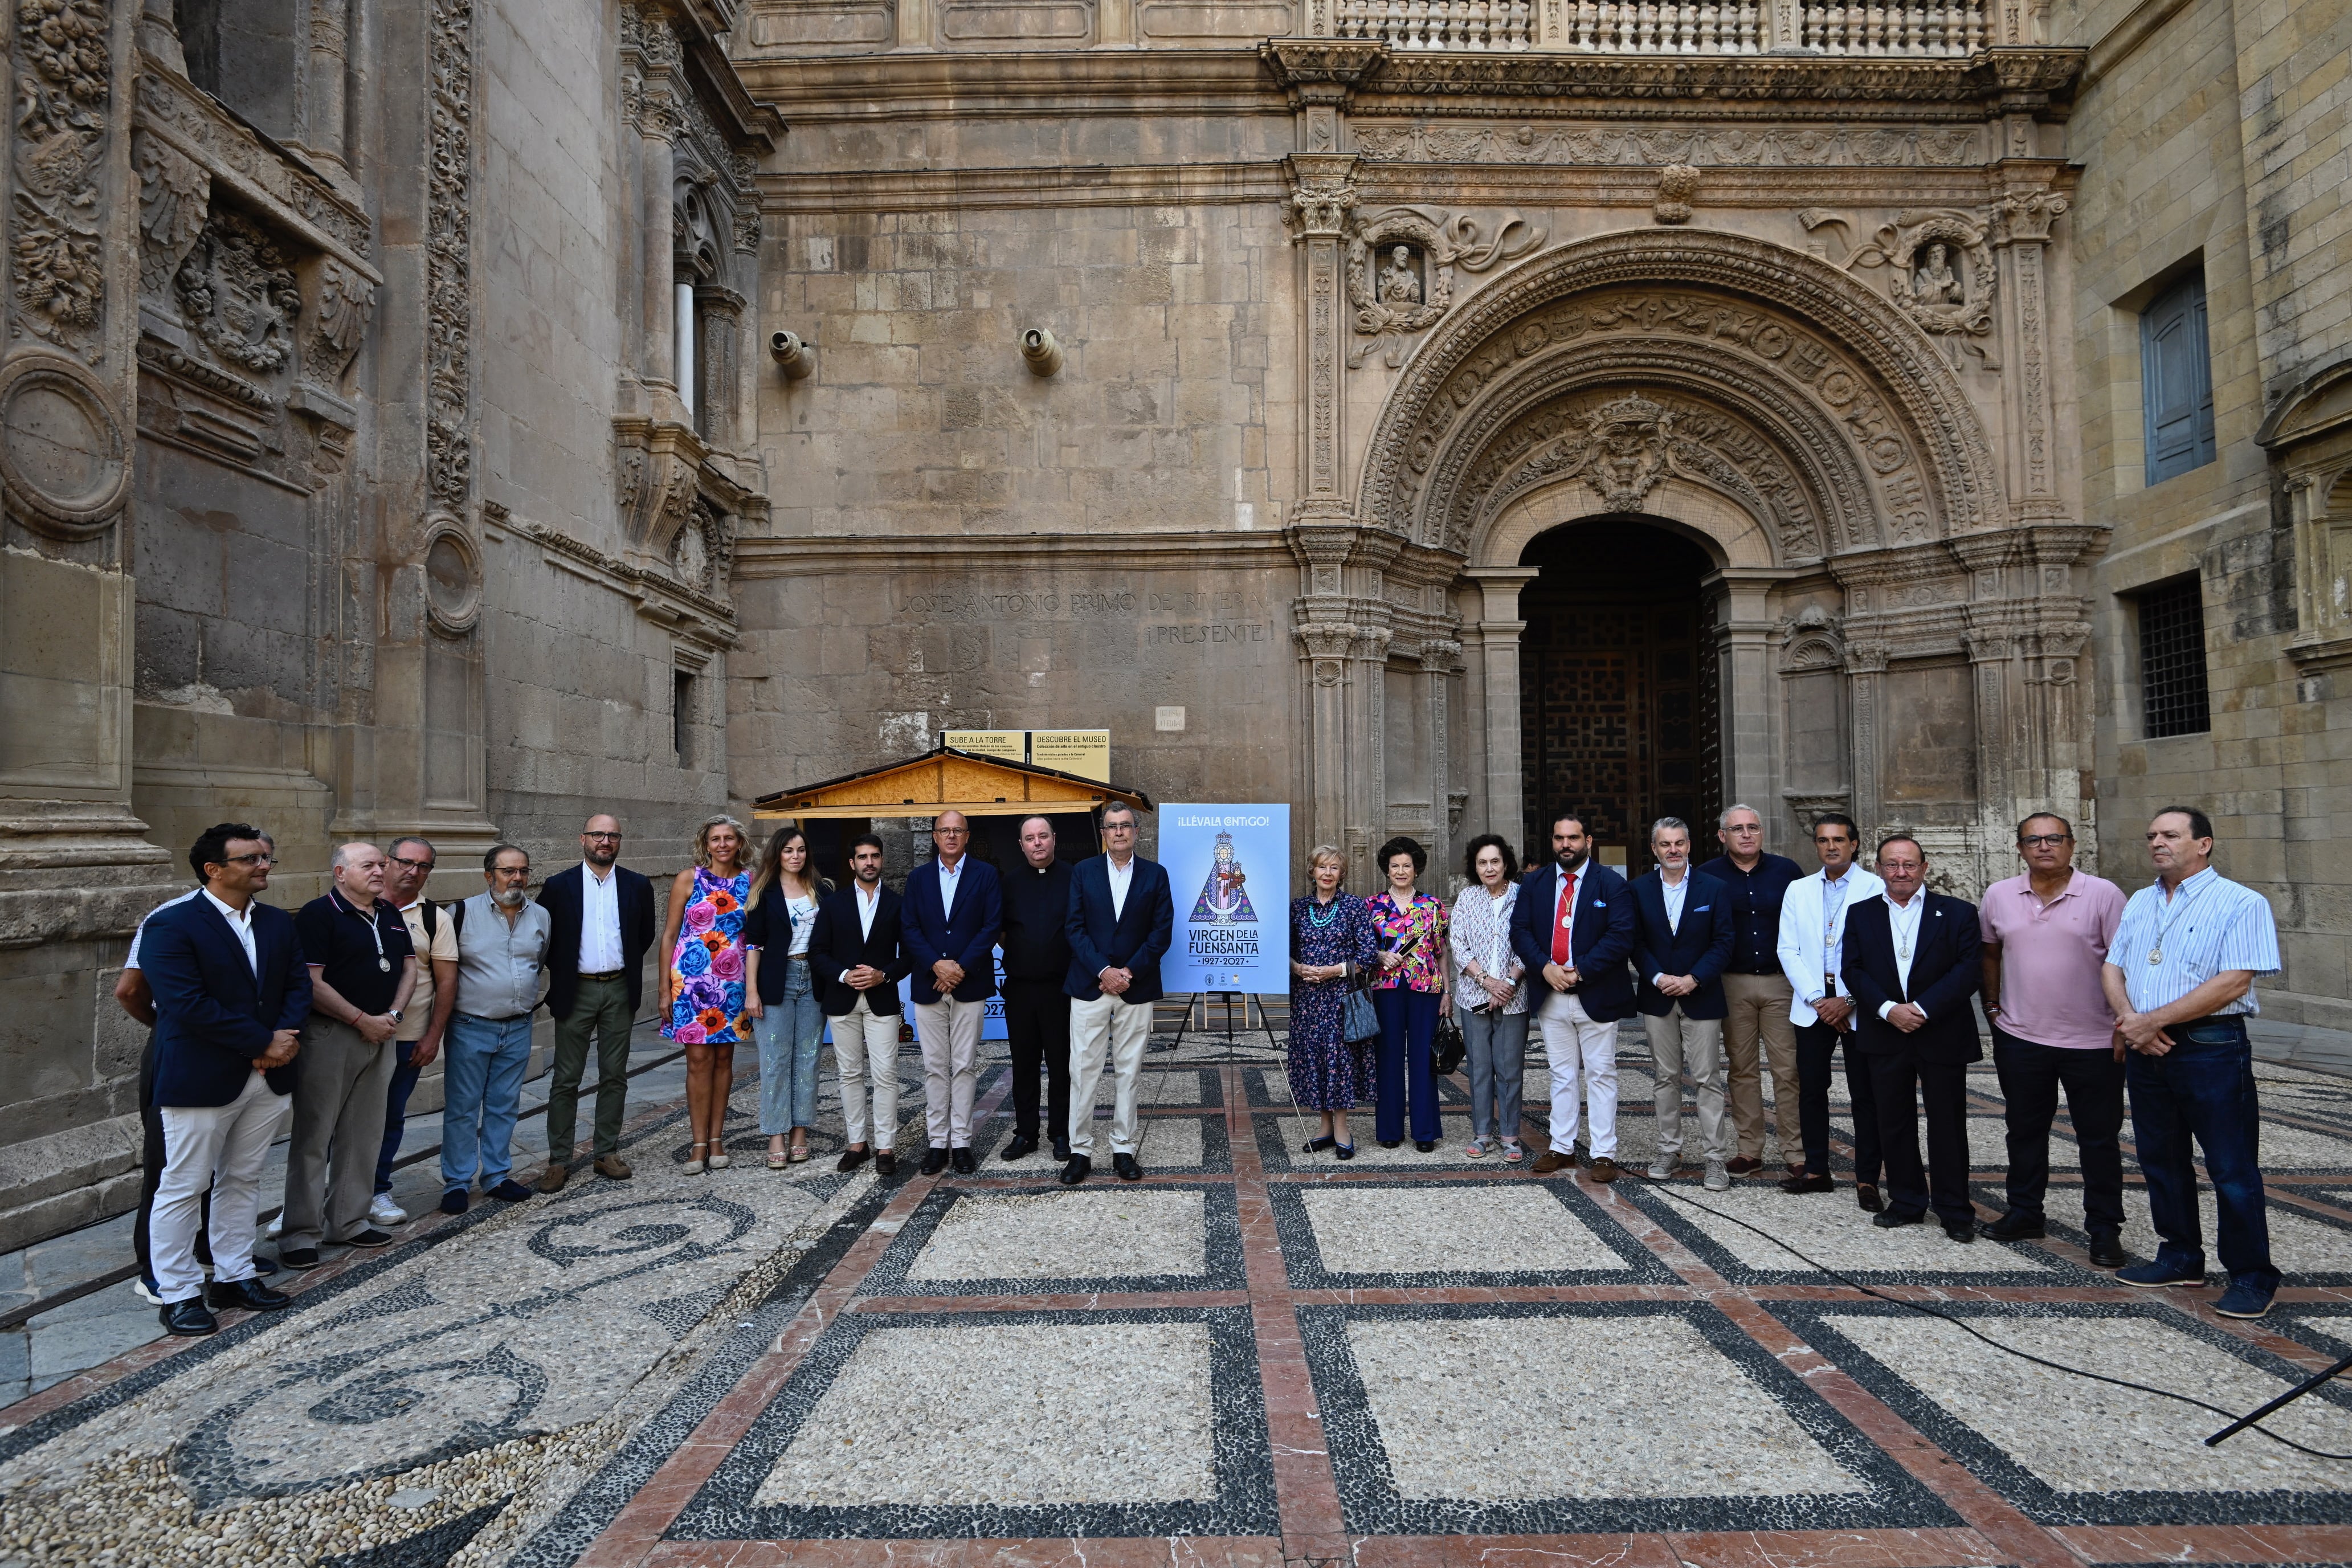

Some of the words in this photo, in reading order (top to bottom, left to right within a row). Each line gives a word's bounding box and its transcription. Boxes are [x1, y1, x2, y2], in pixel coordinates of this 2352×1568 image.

[897, 595, 953, 613] JOSE
[963, 594, 1060, 613] ANTONIO
[1071, 593, 1136, 612] PRIMO
[1148, 593, 1175, 611] DE
[1184, 591, 1263, 611] RIVERA
[1178, 815, 1221, 827] ¡LLÉVALA
[1189, 929, 1234, 941] VIRGEN
[1236, 930, 1248, 938] DE
[1250, 930, 1259, 938] LA
[1189, 942, 1259, 954] FUENSANTA
